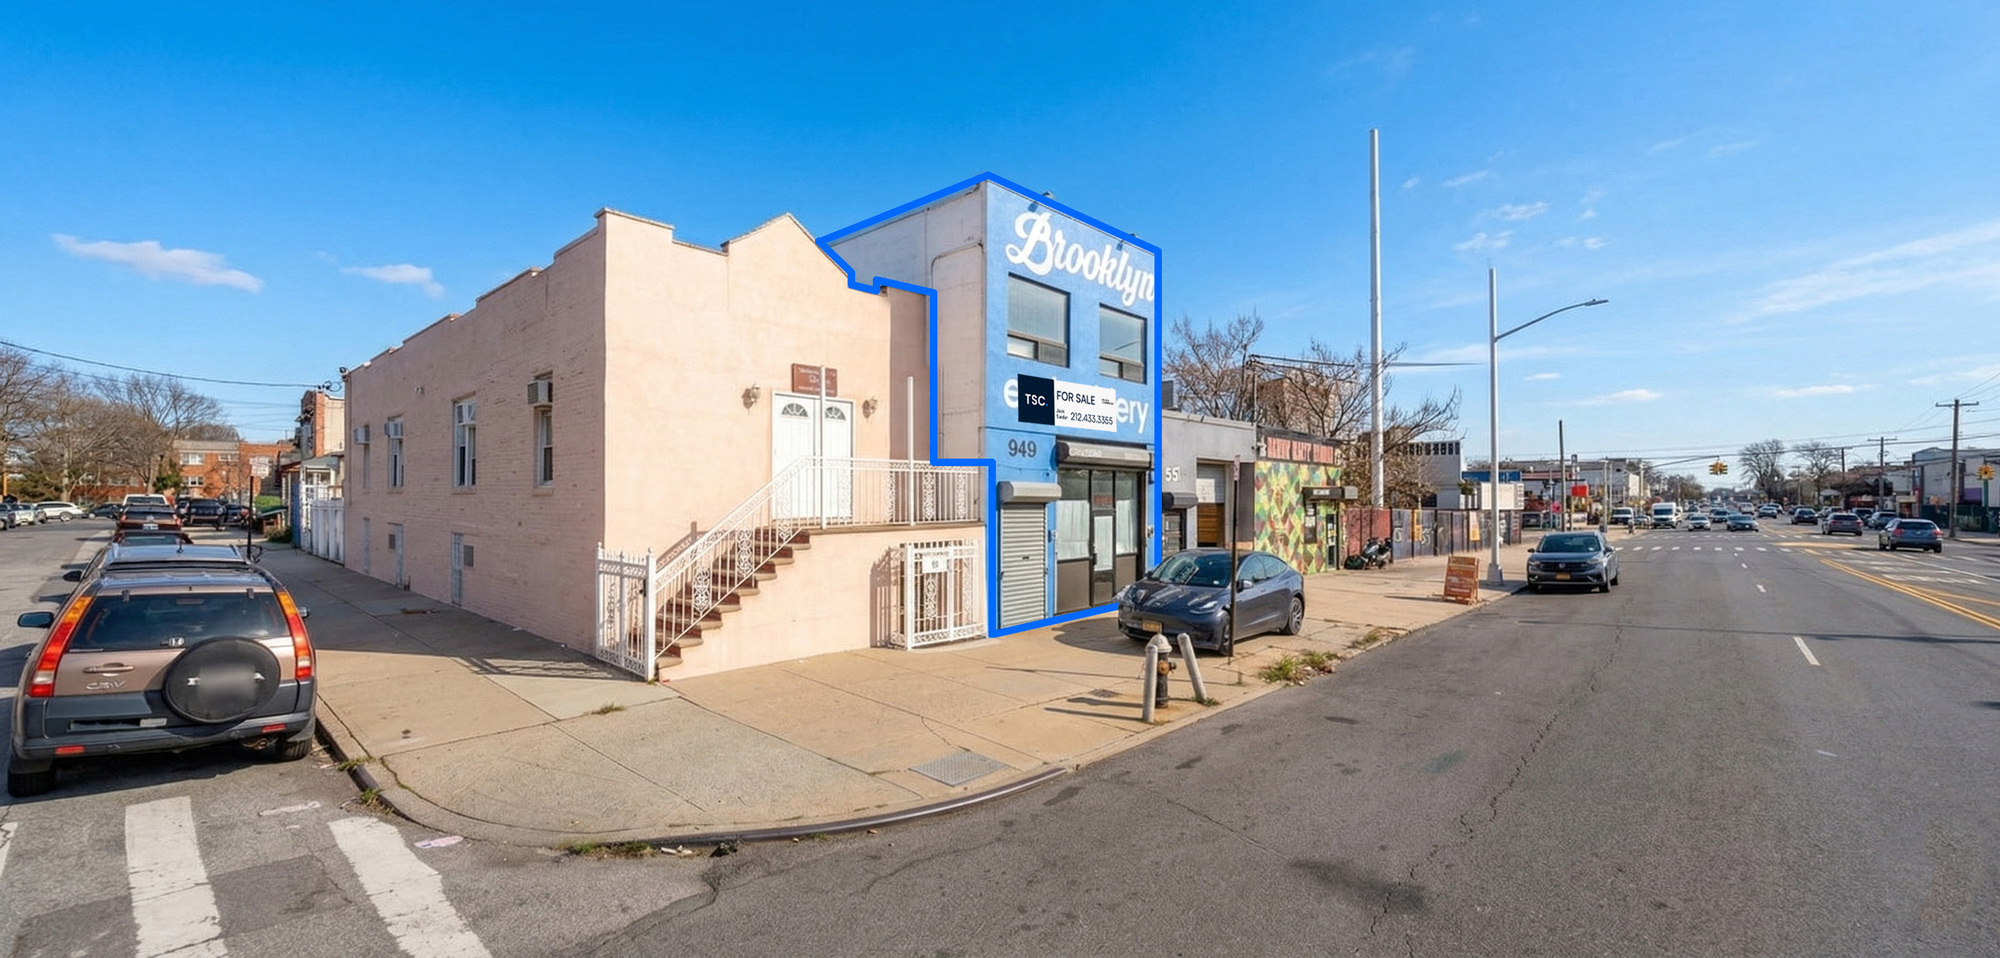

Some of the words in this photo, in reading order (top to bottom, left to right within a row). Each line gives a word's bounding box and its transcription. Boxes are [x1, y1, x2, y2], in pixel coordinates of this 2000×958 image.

[1005, 212, 1155, 307] Brooklyn
[1056, 390, 1074, 403] FOR
[1076, 393, 1096, 405] SALE
[1008, 438, 1037, 458] 949
